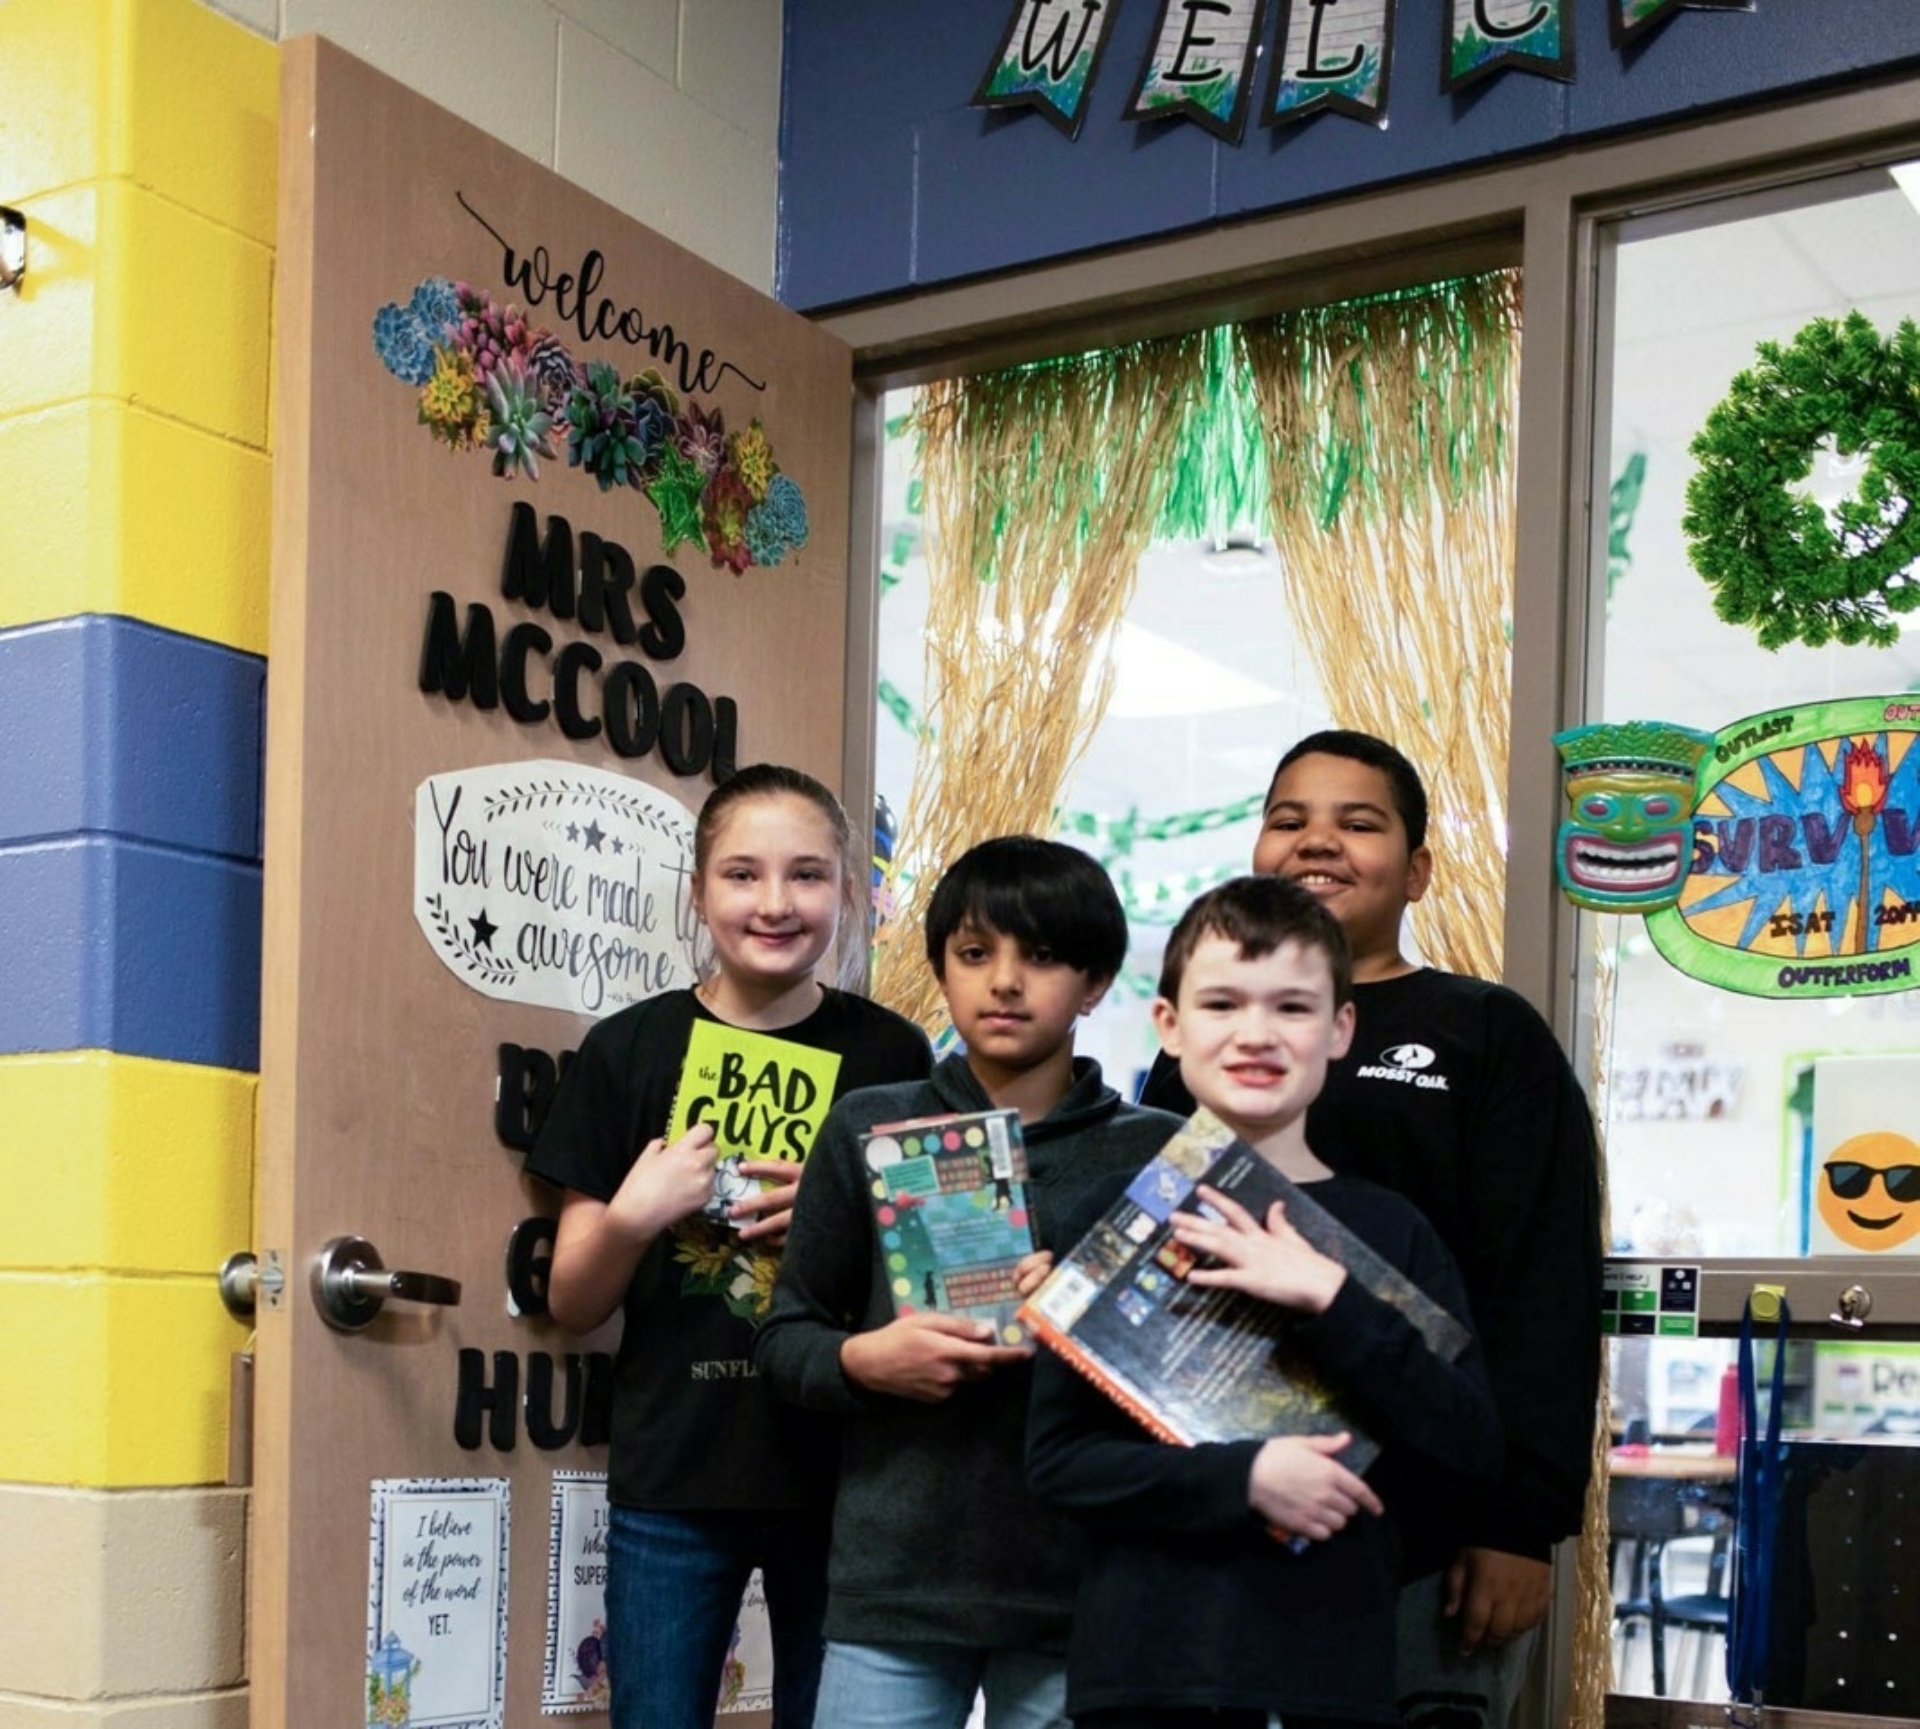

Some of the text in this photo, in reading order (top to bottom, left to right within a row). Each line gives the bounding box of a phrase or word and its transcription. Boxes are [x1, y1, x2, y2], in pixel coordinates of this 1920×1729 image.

[456, 190, 766, 393] welcome
[502, 500, 686, 661] MRS
[1714, 716, 1794, 764] OUTLAST
[429, 780, 492, 889] You
[503, 845, 578, 912] were
[587, 856, 657, 934] made
[1770, 911, 1836, 938] ISAT
[516, 922, 675, 1011] awesome
[1778, 958, 1910, 988] OUTPERFORM
[699, 1066, 718, 1081] the
[717, 1052, 817, 1116] BAD
[1356, 1065, 1418, 1083] MOSSY
[686, 1096, 812, 1163] GUYS
[416, 1510, 472, 1540] I believe
[403, 1539, 482, 1577] in the power
[403, 1571, 481, 1608] of the word
[428, 1613, 453, 1636] YET.
